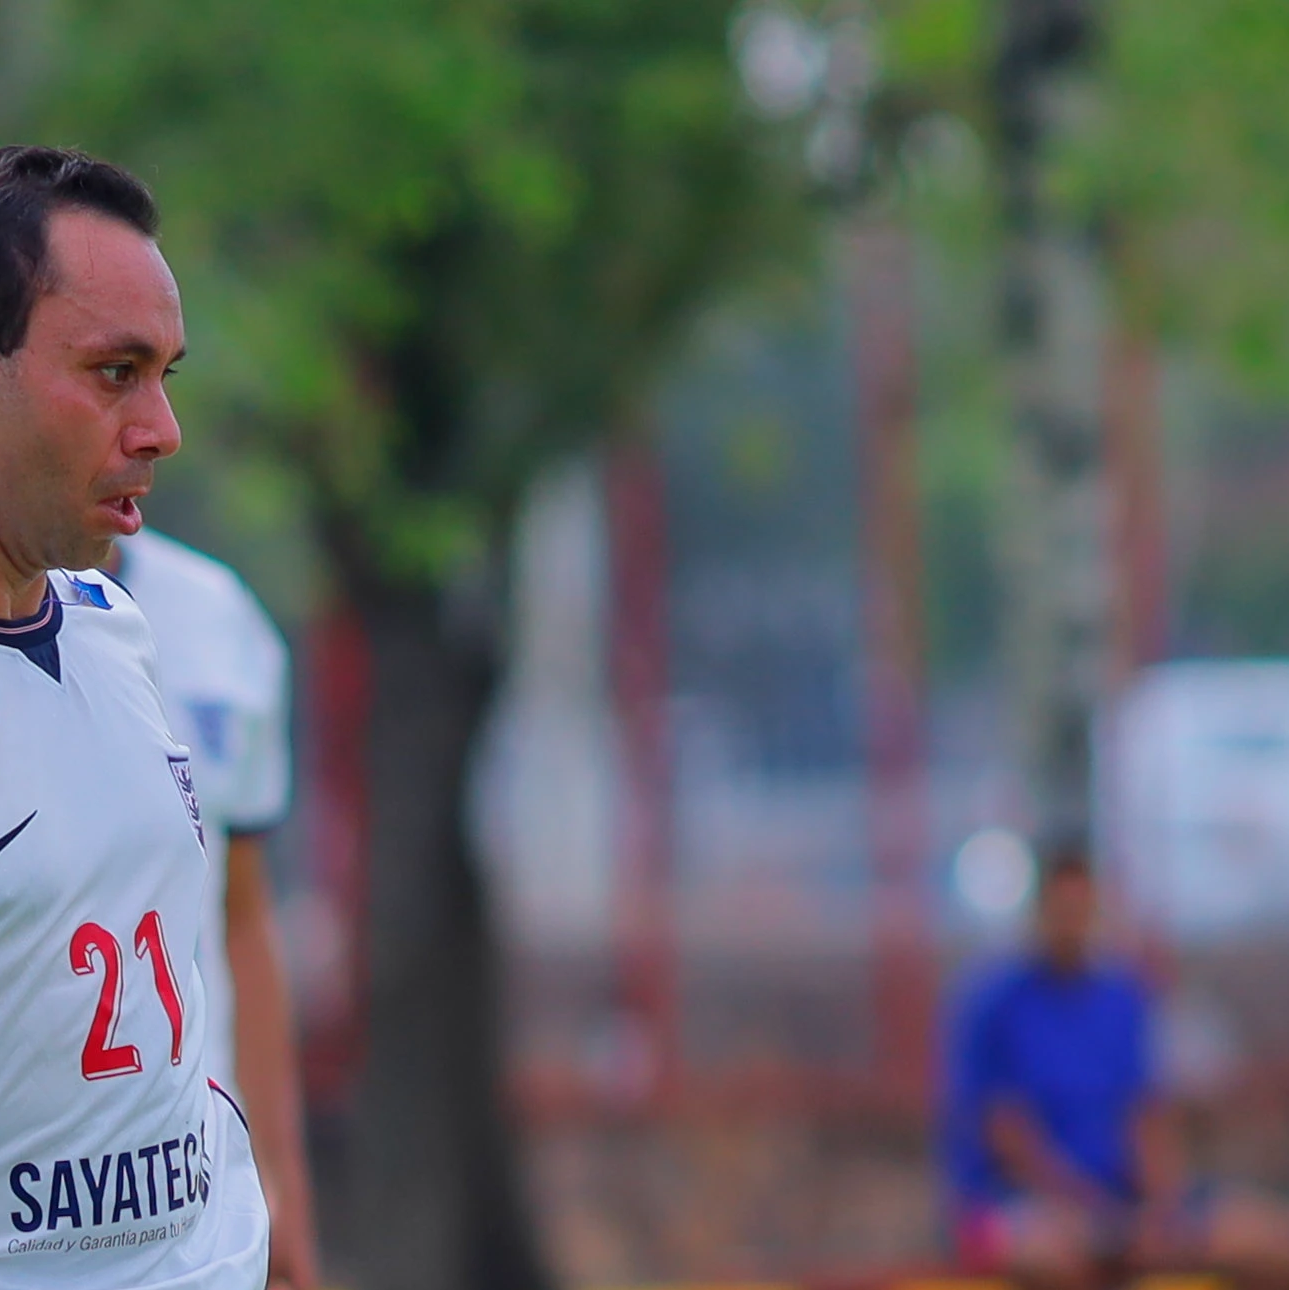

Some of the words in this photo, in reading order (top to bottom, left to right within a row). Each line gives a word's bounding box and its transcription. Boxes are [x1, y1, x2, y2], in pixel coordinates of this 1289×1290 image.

[69, 910, 185, 1081] 21
[9, 1132, 197, 1233] SAYATEC
[8, 1238, 64, 1254] Calidad
[65, 1241, 76, 1252] y
[138, 1226, 167, 1247] para
